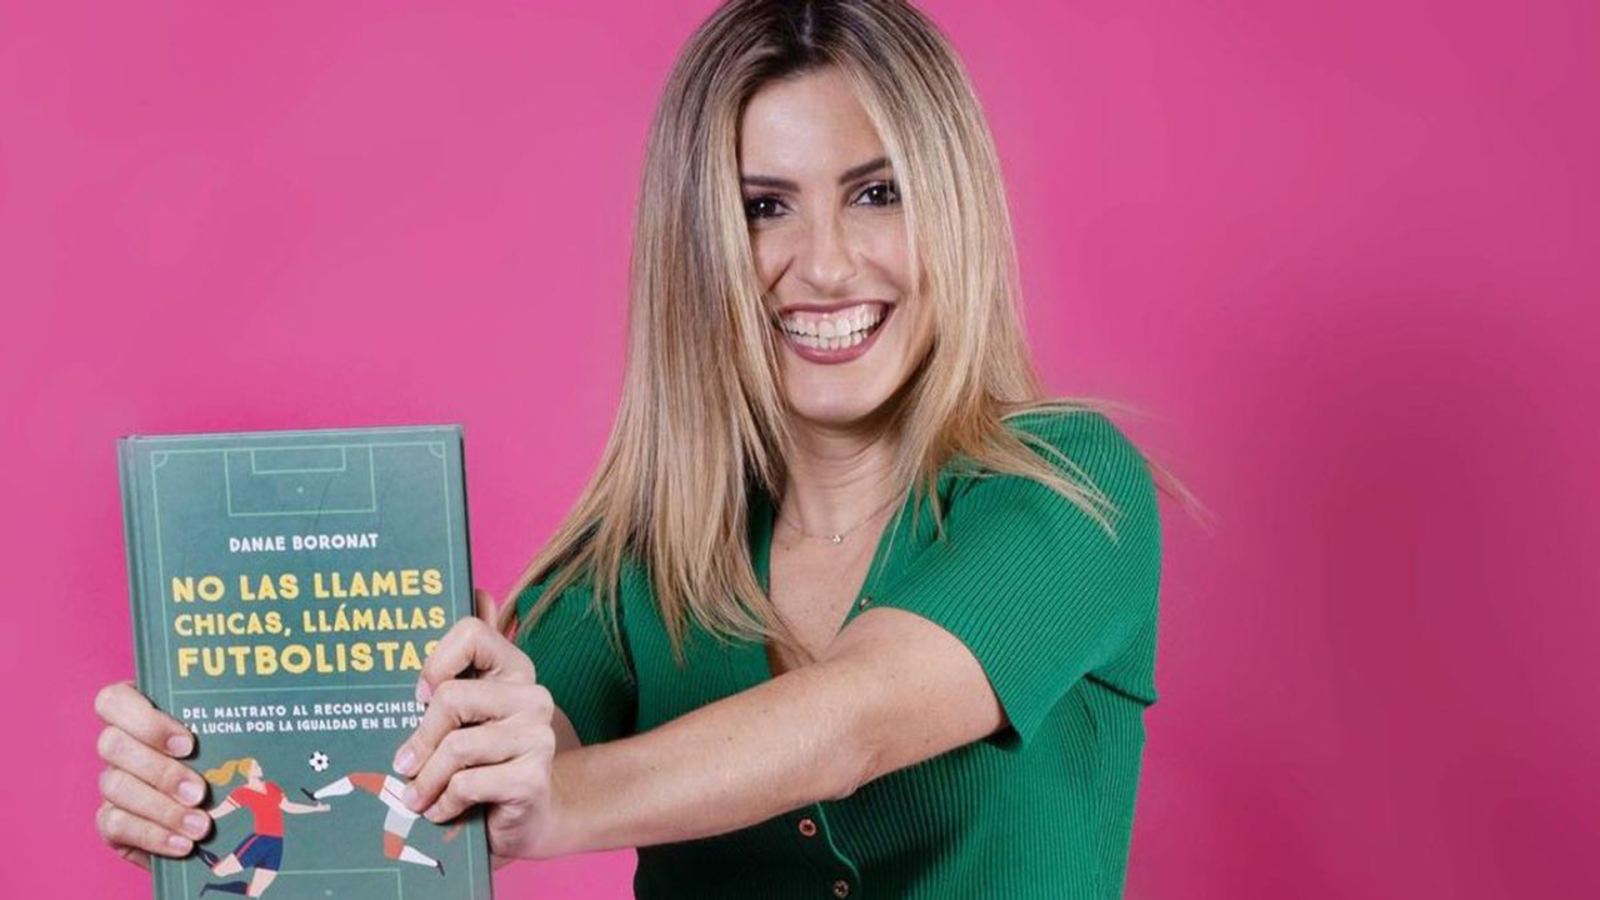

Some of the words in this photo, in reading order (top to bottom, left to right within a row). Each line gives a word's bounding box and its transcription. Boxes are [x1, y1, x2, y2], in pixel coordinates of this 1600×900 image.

[229, 536, 285, 552] DANAE
[292, 533, 379, 551] BORONAT
[172, 576, 225, 603] NO
[240, 573, 299, 600] LAS
[314, 569, 443, 598] LLAMES
[174, 611, 291, 637] CHICAS,
[303, 603, 445, 632] LLÁMALAS
[183, 706, 207, 719] DEL
[214, 704, 286, 717] MALTRATO
[292, 703, 308, 716] AL
[314, 701, 425, 716] RECONOCIMIEN
[203, 721, 243, 734] LUCHA
[246, 719, 275, 732] POR
[279, 718, 293, 731] LA
[297, 715, 357, 731] IGUALDAD
[361, 717, 379, 729] EN
[384, 716, 397, 728] EL
